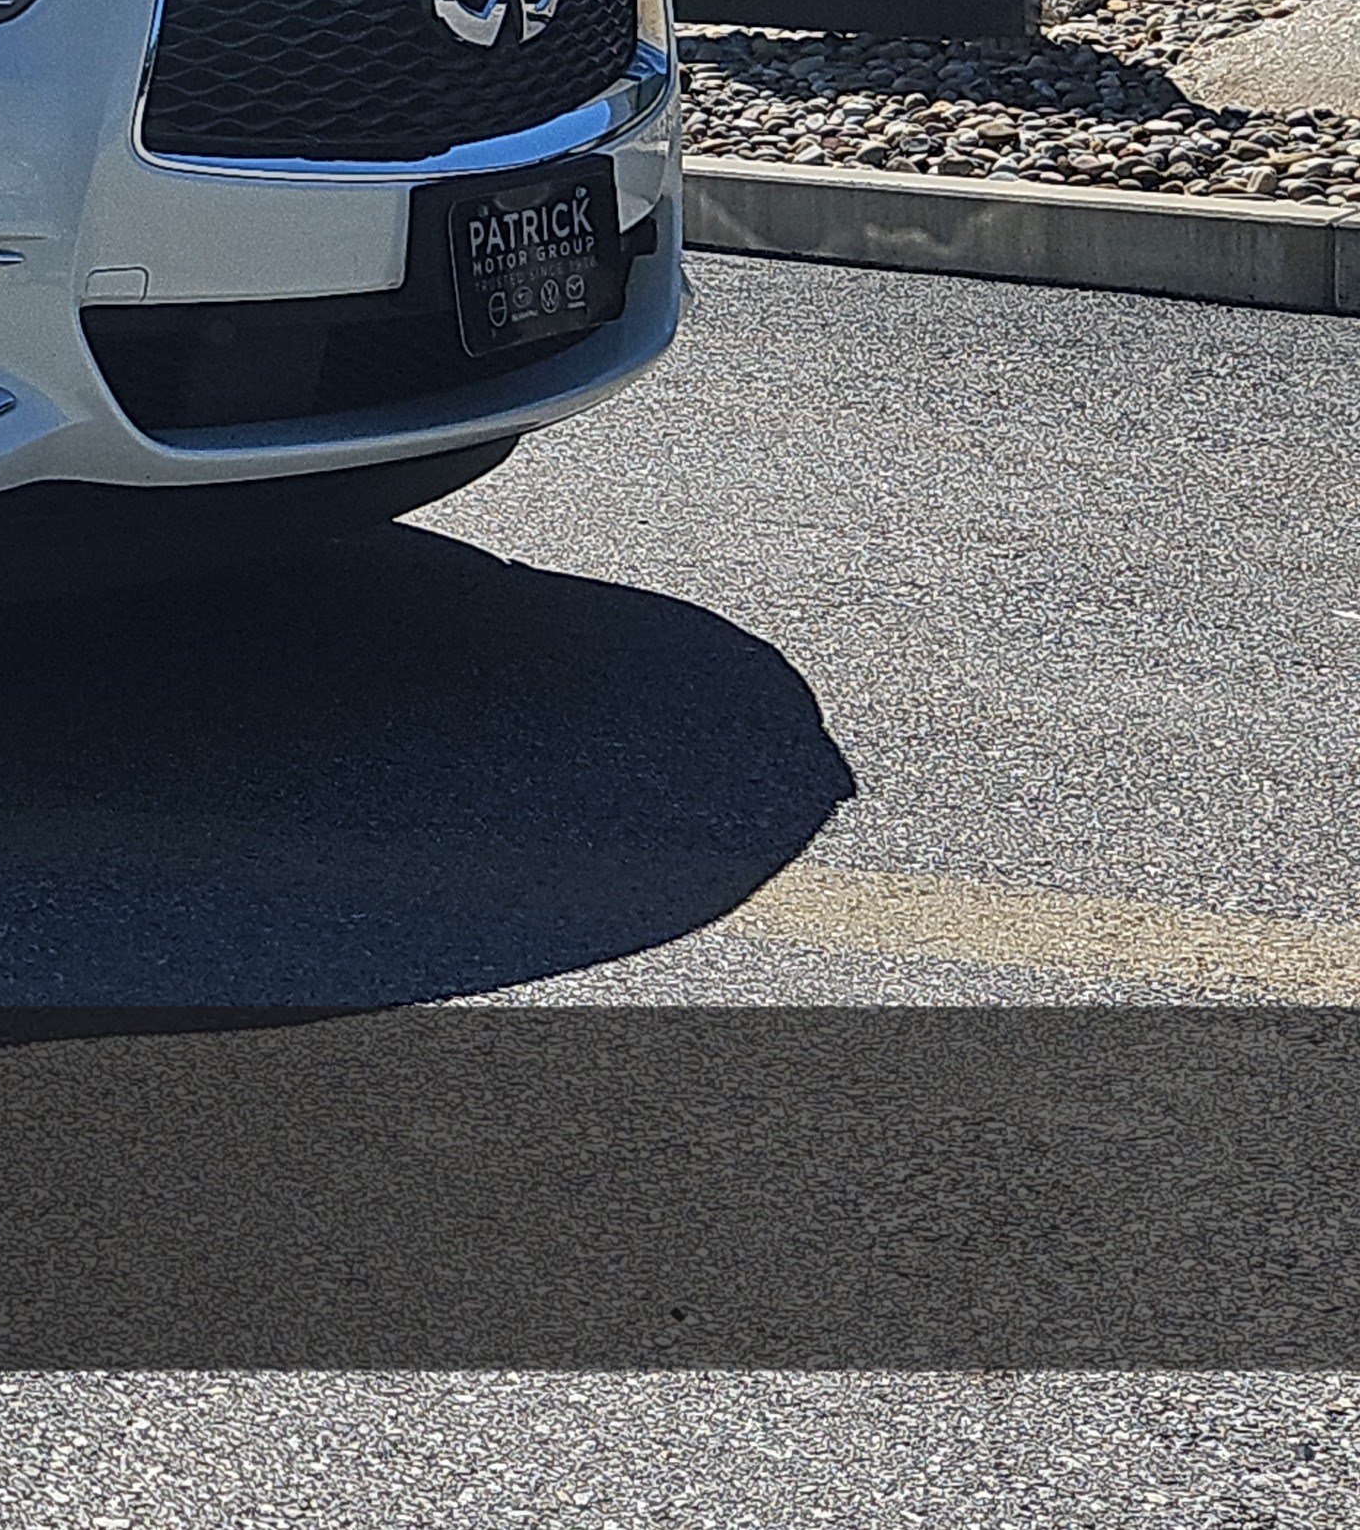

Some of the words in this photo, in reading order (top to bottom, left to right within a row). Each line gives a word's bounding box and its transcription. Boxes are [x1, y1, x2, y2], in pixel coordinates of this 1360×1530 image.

[469, 197, 594, 258] PATRICK
[473, 250, 529, 276] MOTOR
[536, 235, 596, 261] GROUP
